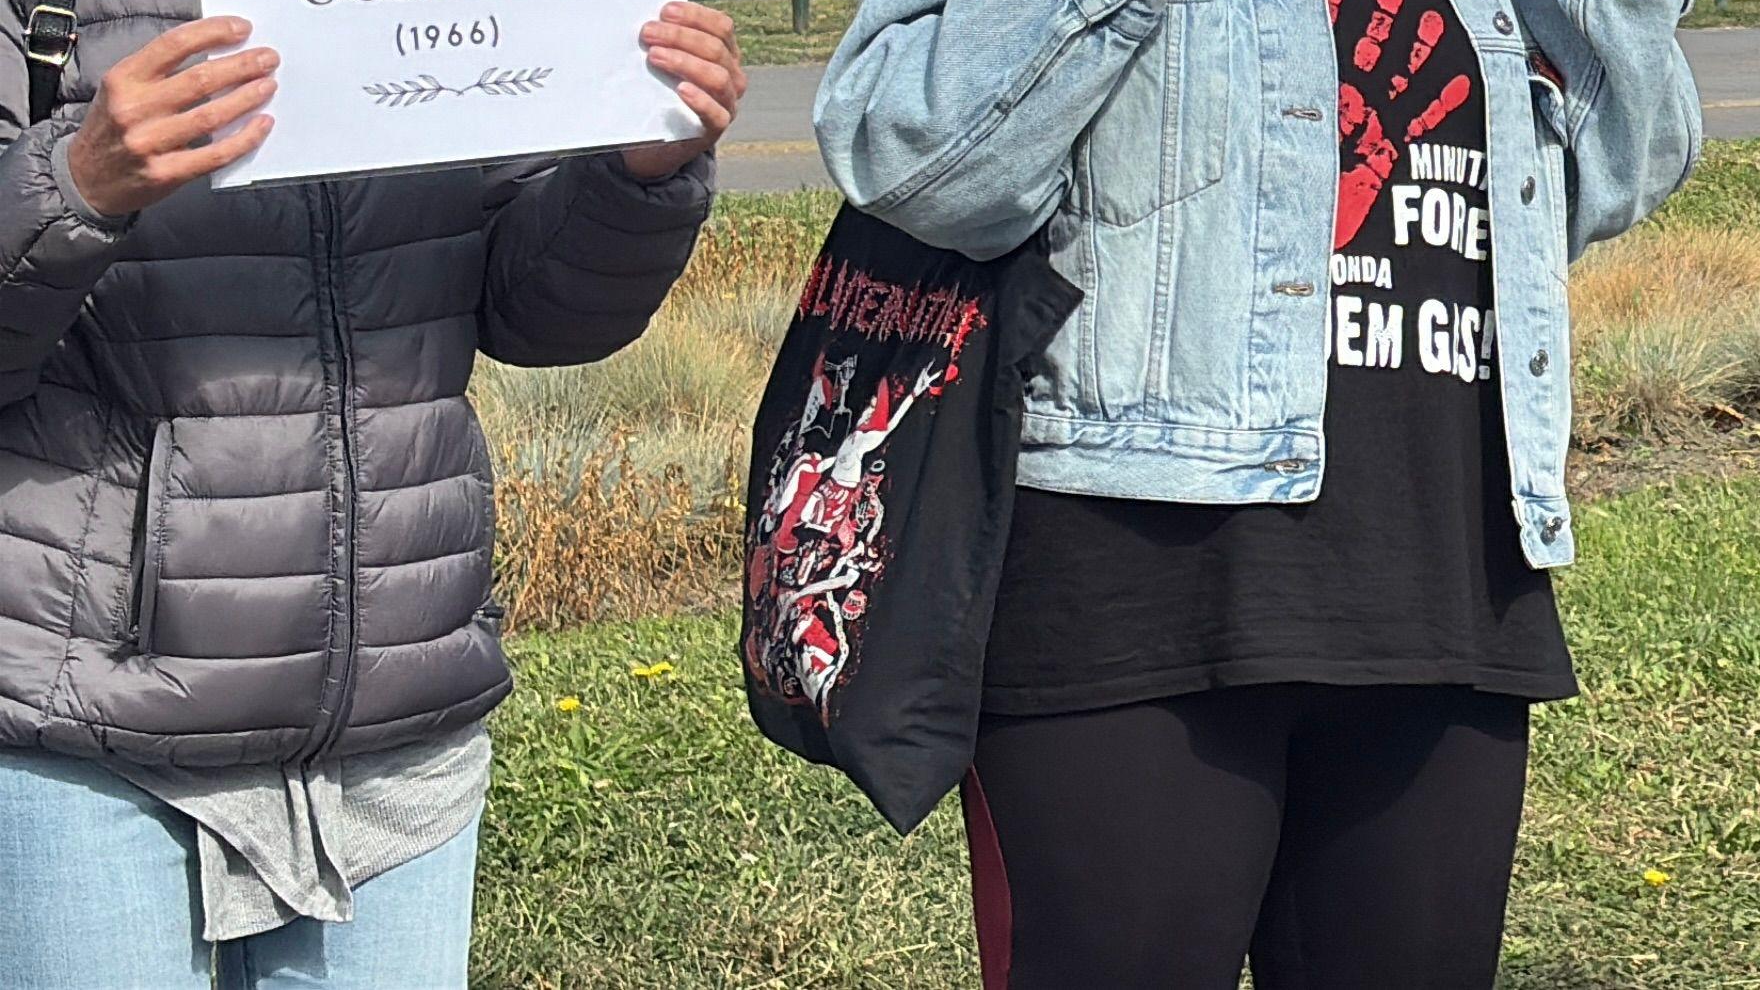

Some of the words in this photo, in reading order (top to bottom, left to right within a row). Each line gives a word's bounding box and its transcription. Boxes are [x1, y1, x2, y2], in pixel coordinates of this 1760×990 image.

[396, 15, 500, 56] (1966)
[1409, 142, 1488, 191] MINUT
[1327, 295, 1404, 369] EM
